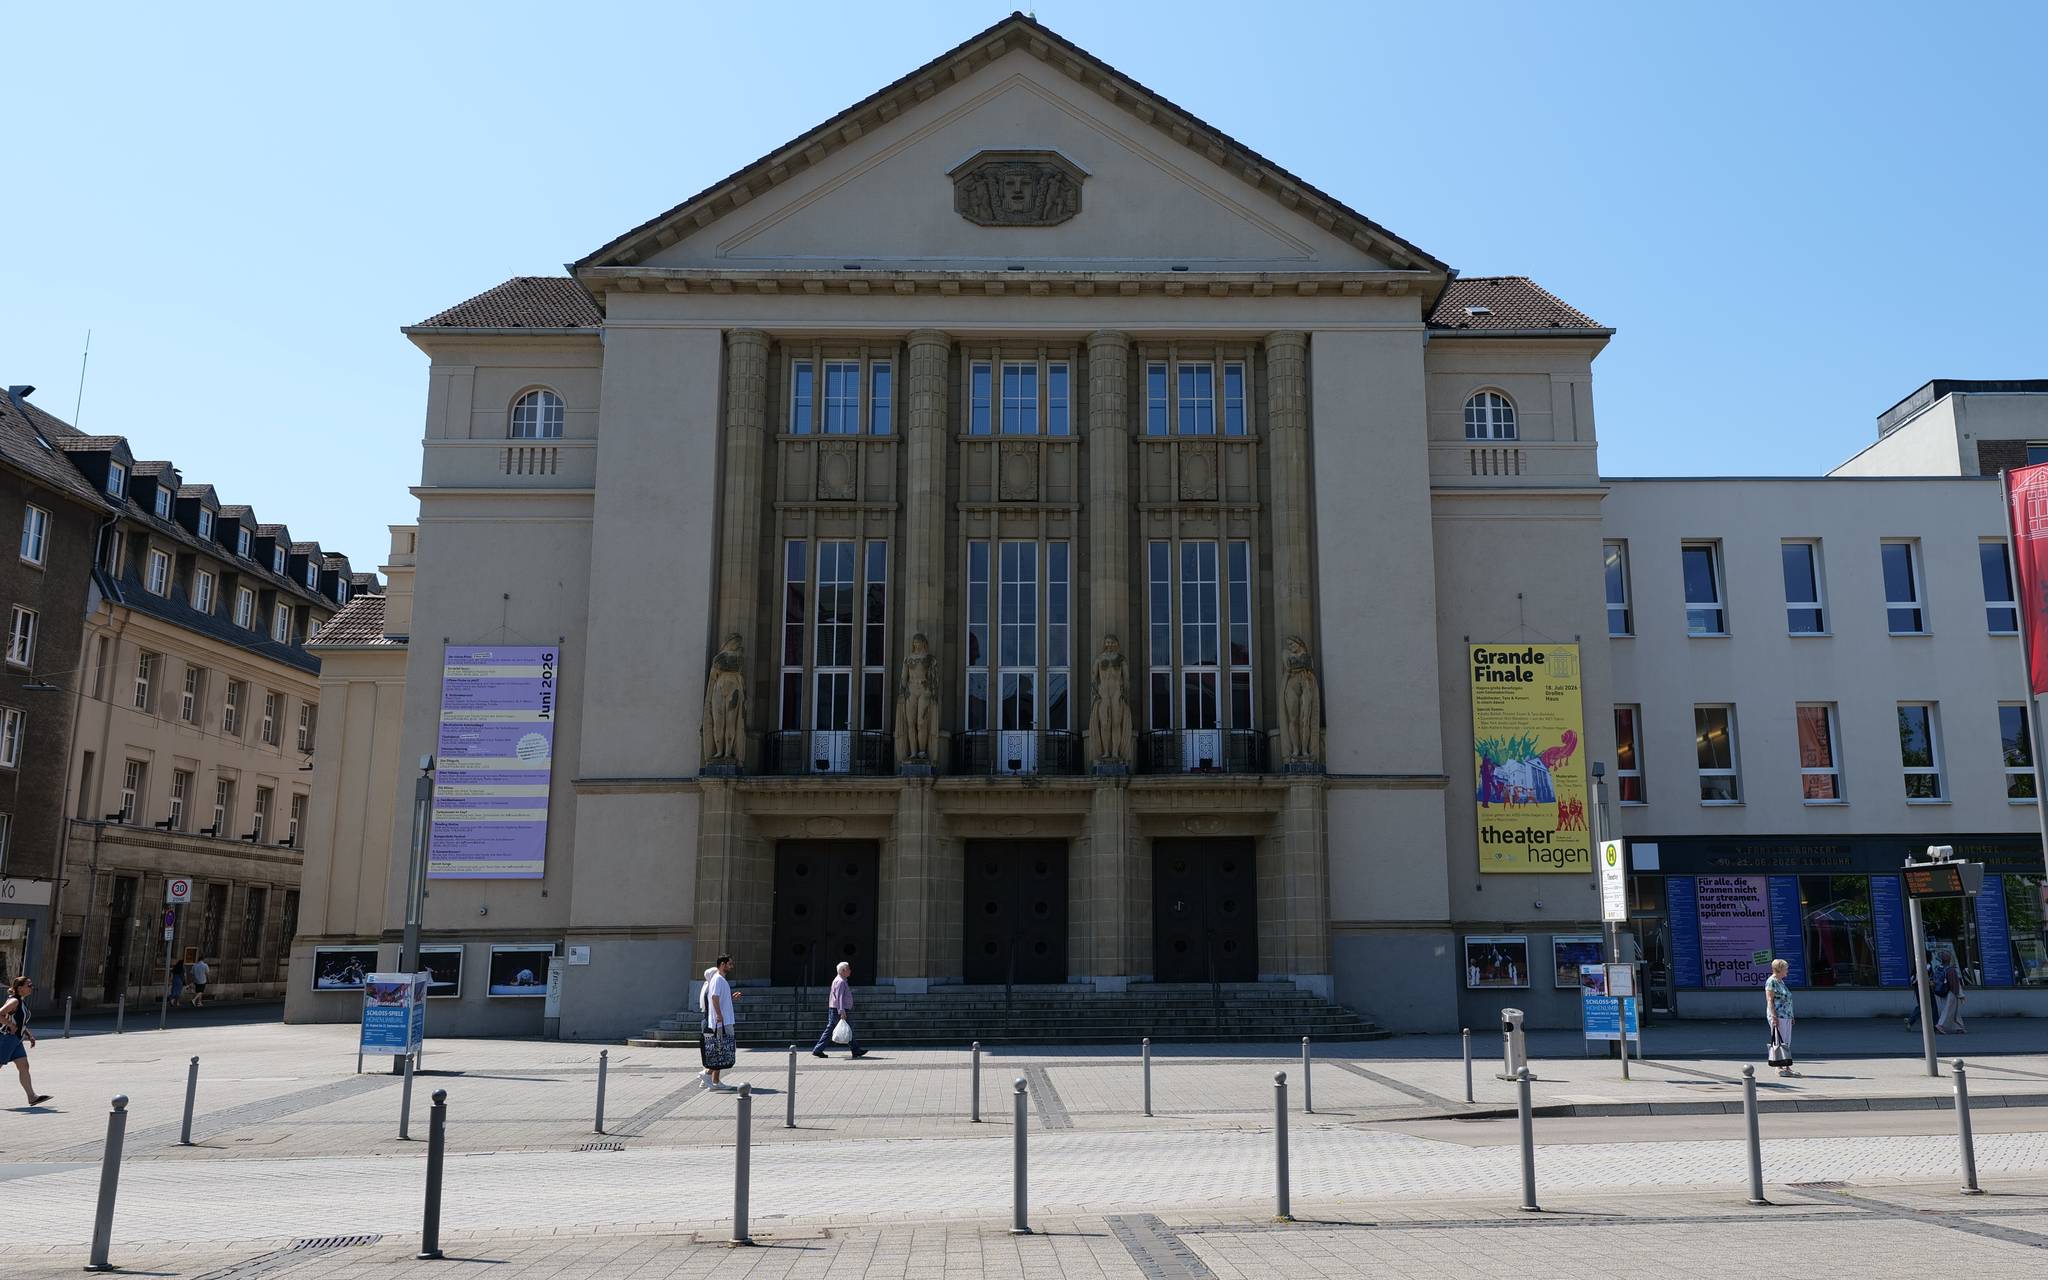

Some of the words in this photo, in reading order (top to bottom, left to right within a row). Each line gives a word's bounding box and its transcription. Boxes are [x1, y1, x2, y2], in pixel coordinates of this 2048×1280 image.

[1473, 647, 1545, 665] Grande
[541, 652, 554, 689] 2026
[1474, 665, 1534, 682] Finale
[538, 691, 552, 720] Juni
[1481, 825, 1555, 844] theater
[1528, 844, 1589, 868] hagen
[175, 884, 185, 893] 30
[1698, 877, 1713, 886] Für
[1714, 877, 1733, 887] alle,
[1734, 877, 1747, 886] die
[1699, 885, 1733, 894] Dramen
[1735, 885, 1758, 894] nicht
[1716, 894, 1760, 903] streamen,
[1701, 909, 1731, 919] spüren
[1732, 908, 1766, 917] wollen!
[1705, 958, 1752, 970] theater
